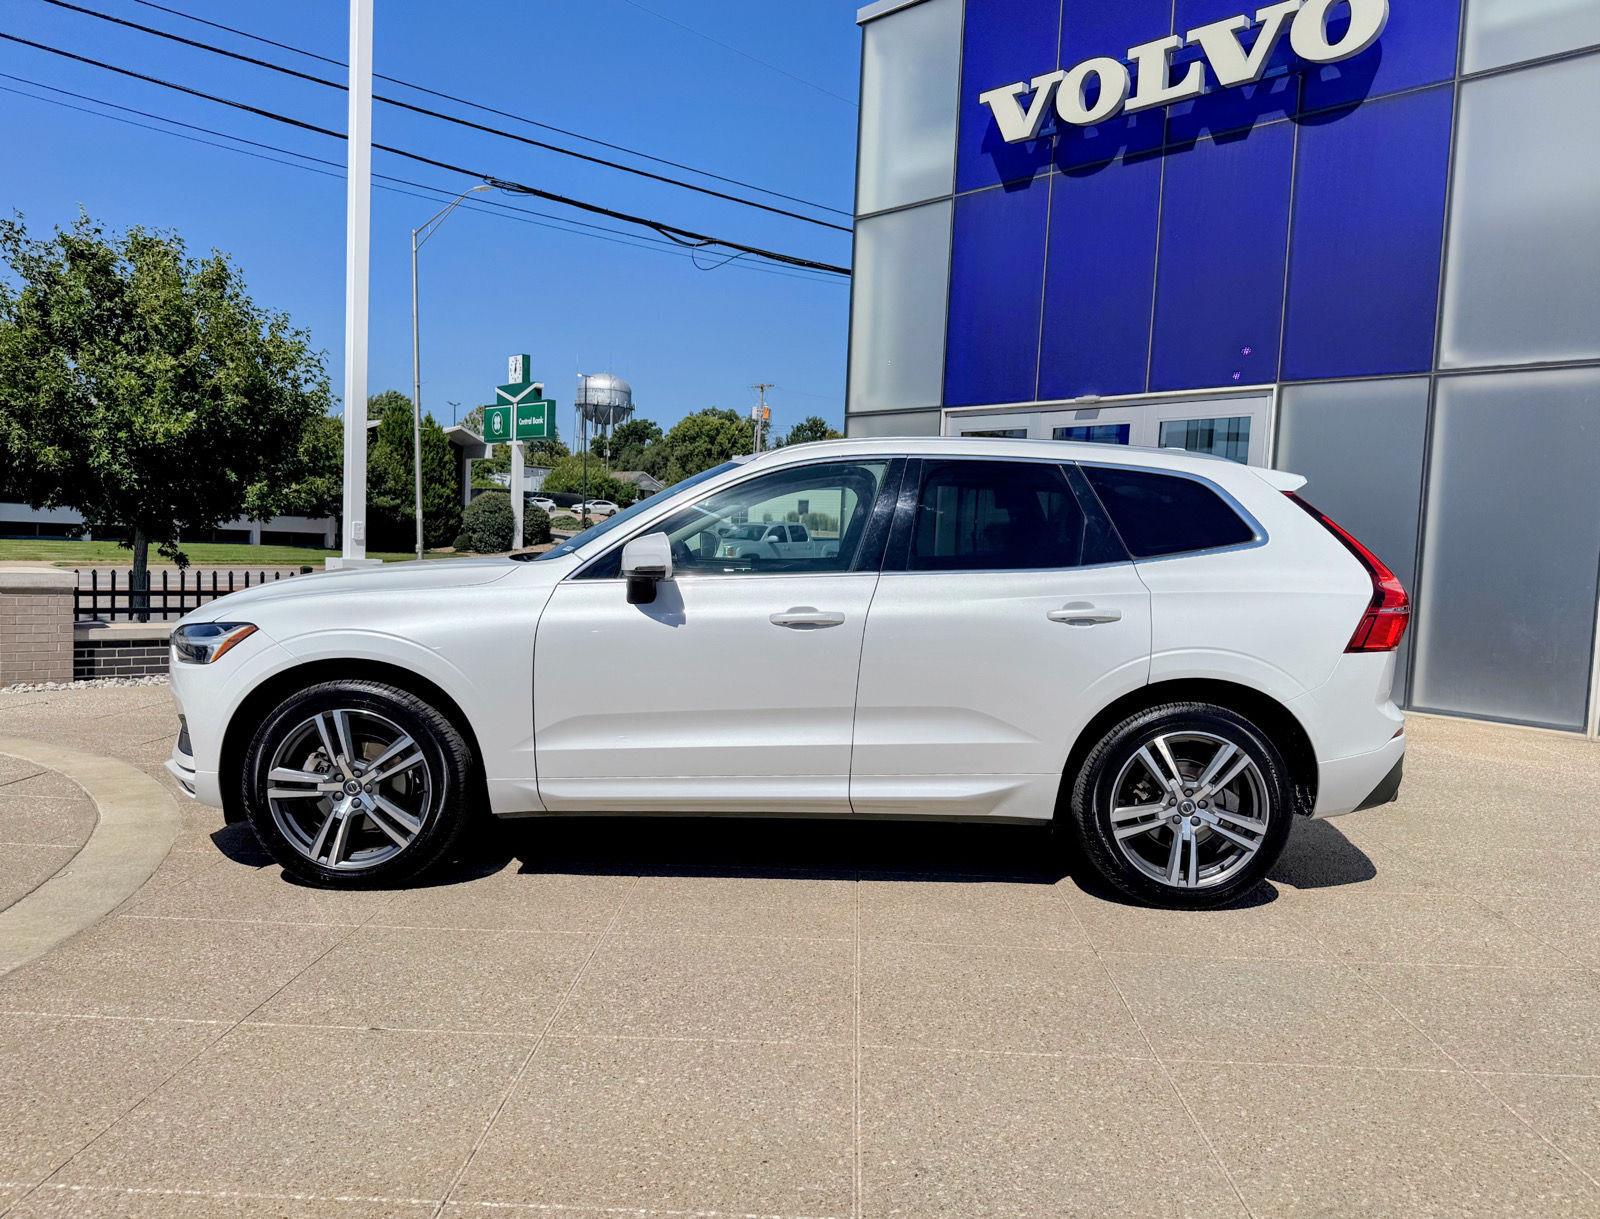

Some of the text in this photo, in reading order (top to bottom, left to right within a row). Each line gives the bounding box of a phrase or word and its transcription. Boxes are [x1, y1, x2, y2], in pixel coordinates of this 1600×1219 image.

[979, 0, 1389, 143] VOLVO
[519, 416, 544, 425] Central Bank
